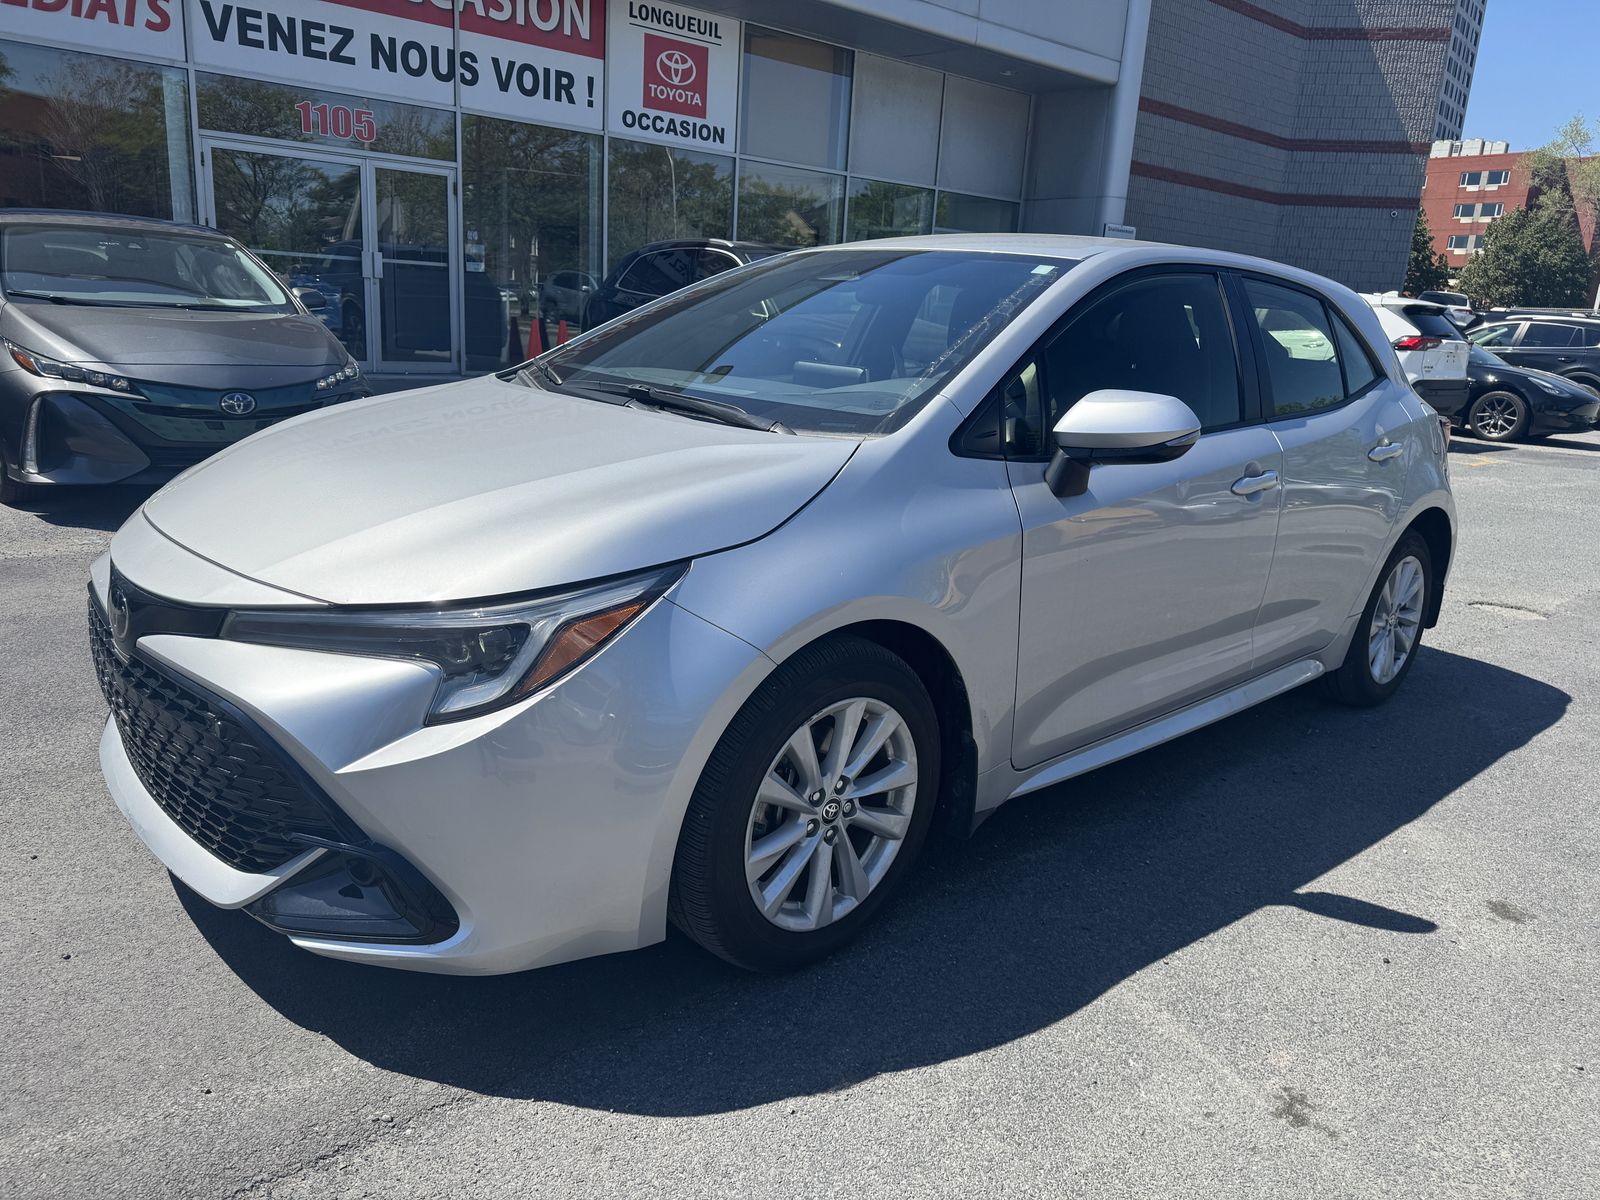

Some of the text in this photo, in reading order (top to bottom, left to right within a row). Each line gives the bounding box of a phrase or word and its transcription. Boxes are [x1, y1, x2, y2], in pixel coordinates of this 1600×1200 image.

[0, 0, 171, 33] ATS
[629, 1, 722, 40] LONGUEUIL
[202, 1, 356, 66] VENEZ
[370, 33, 480, 87] NOUS
[491, 56, 576, 105] VOIR
[648, 83, 702, 107] TOYOTA
[295, 100, 377, 143] 1105
[621, 109, 725, 144] OCCASION
